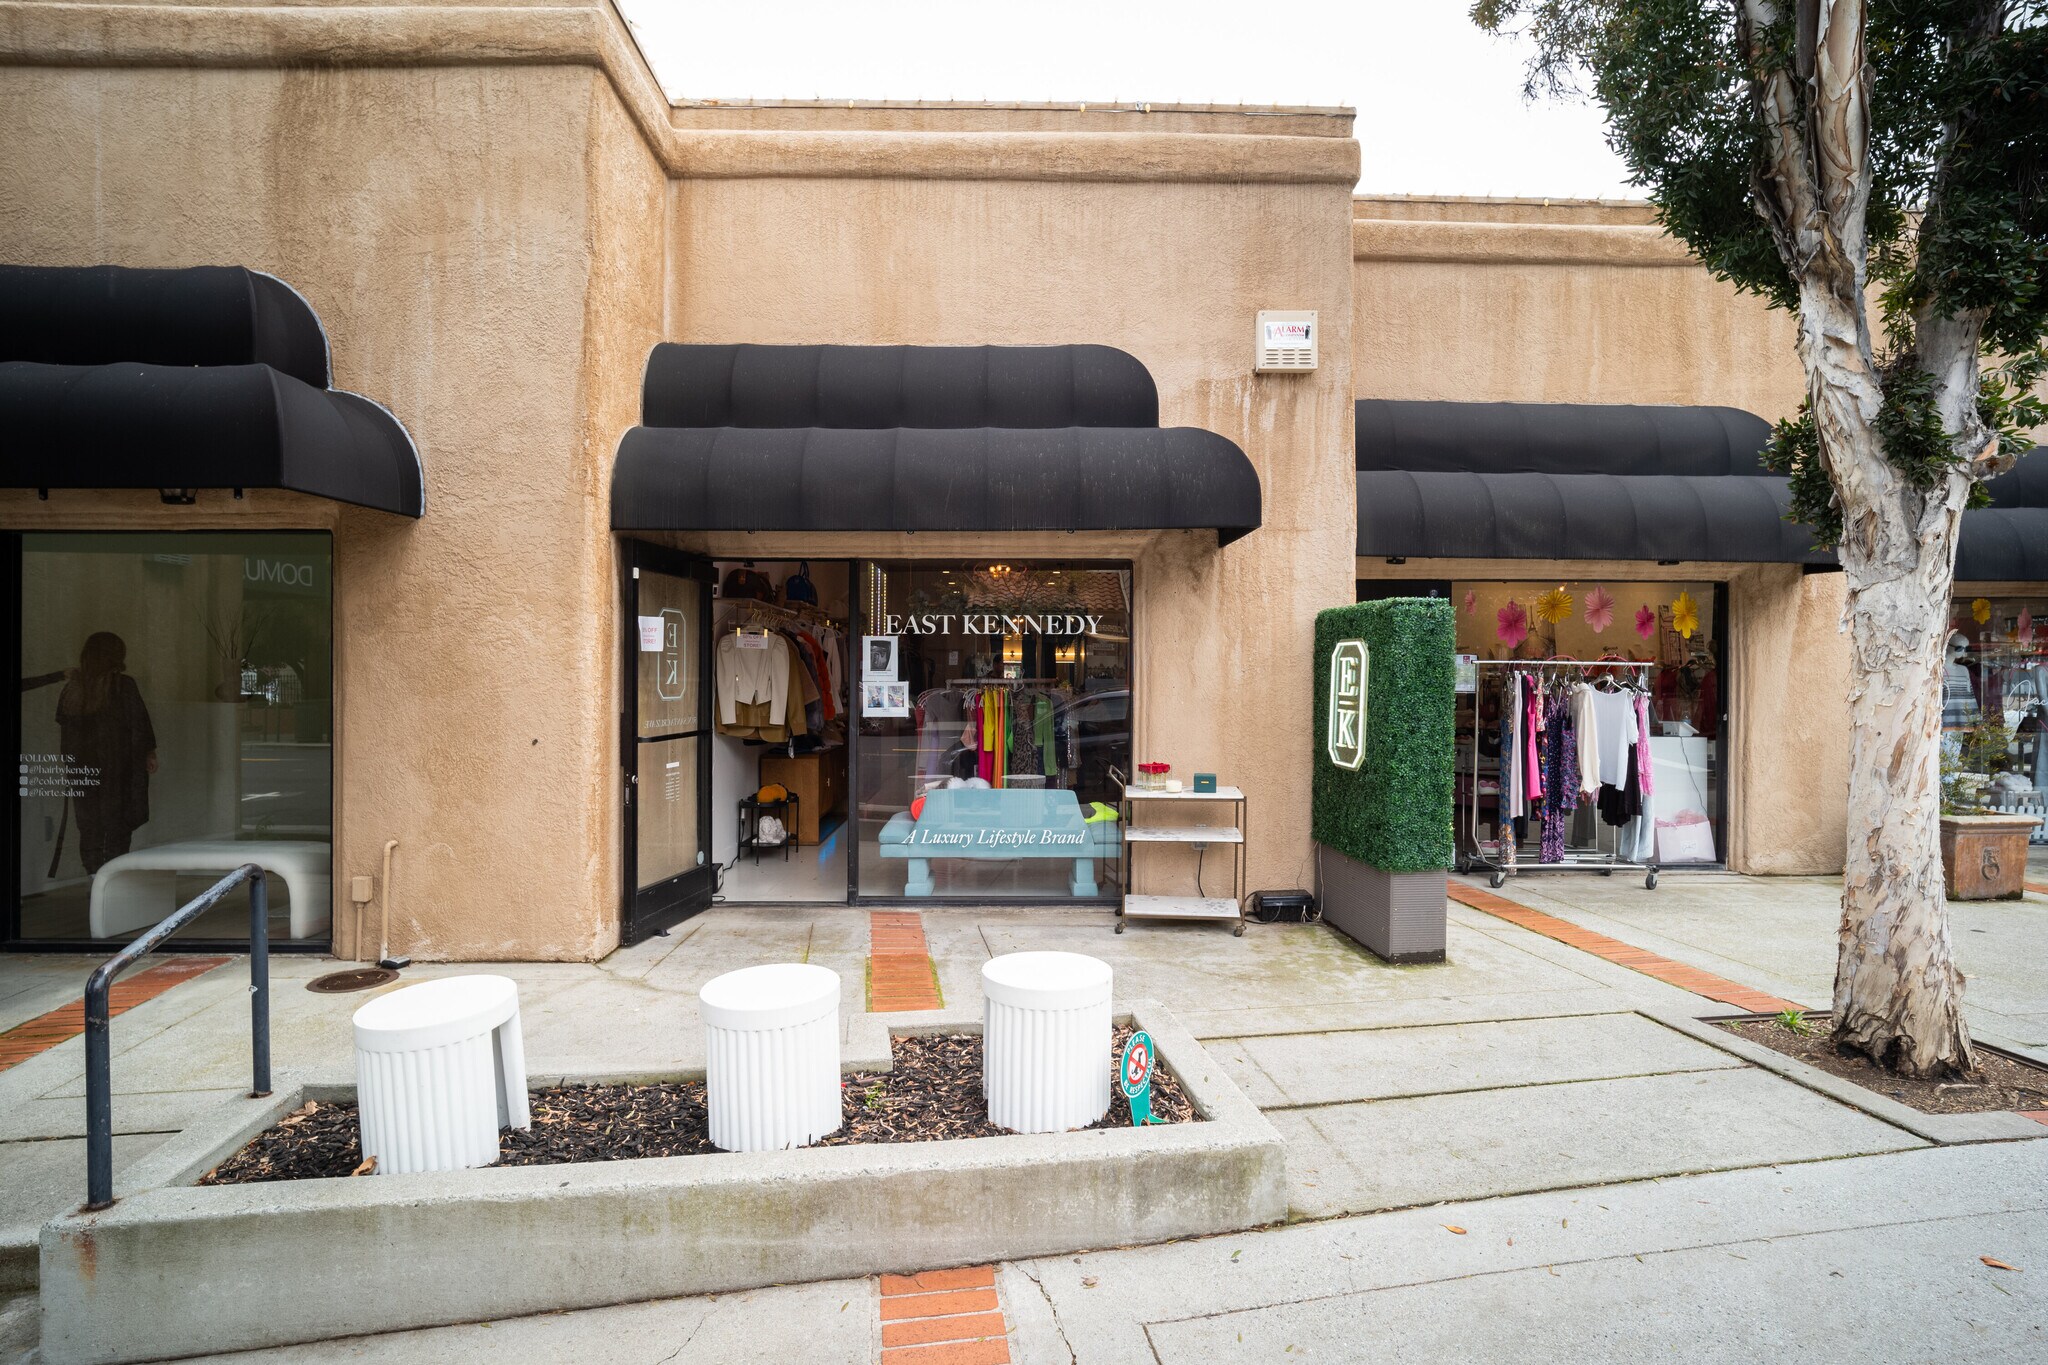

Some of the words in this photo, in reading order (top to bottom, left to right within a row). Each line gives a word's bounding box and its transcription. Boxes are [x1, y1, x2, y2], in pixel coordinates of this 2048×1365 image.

[1274, 326, 1305, 336] ALARM
[885, 614, 956, 635] EAST
[962, 614, 1103, 635] KENNEDY
[20, 754, 58, 762] FOLLOW
[60, 754, 76, 762] US:
[29, 765, 102, 776] @hairbykendyyy
[29, 776, 101, 787] @colorbyandres
[902, 829, 916, 844] A
[920, 829, 974, 848] Luxury
[977, 829, 1037, 848] Lifestyle
[1039, 829, 1087, 844] Brand
[1127, 1034, 1146, 1055] PLEASE
